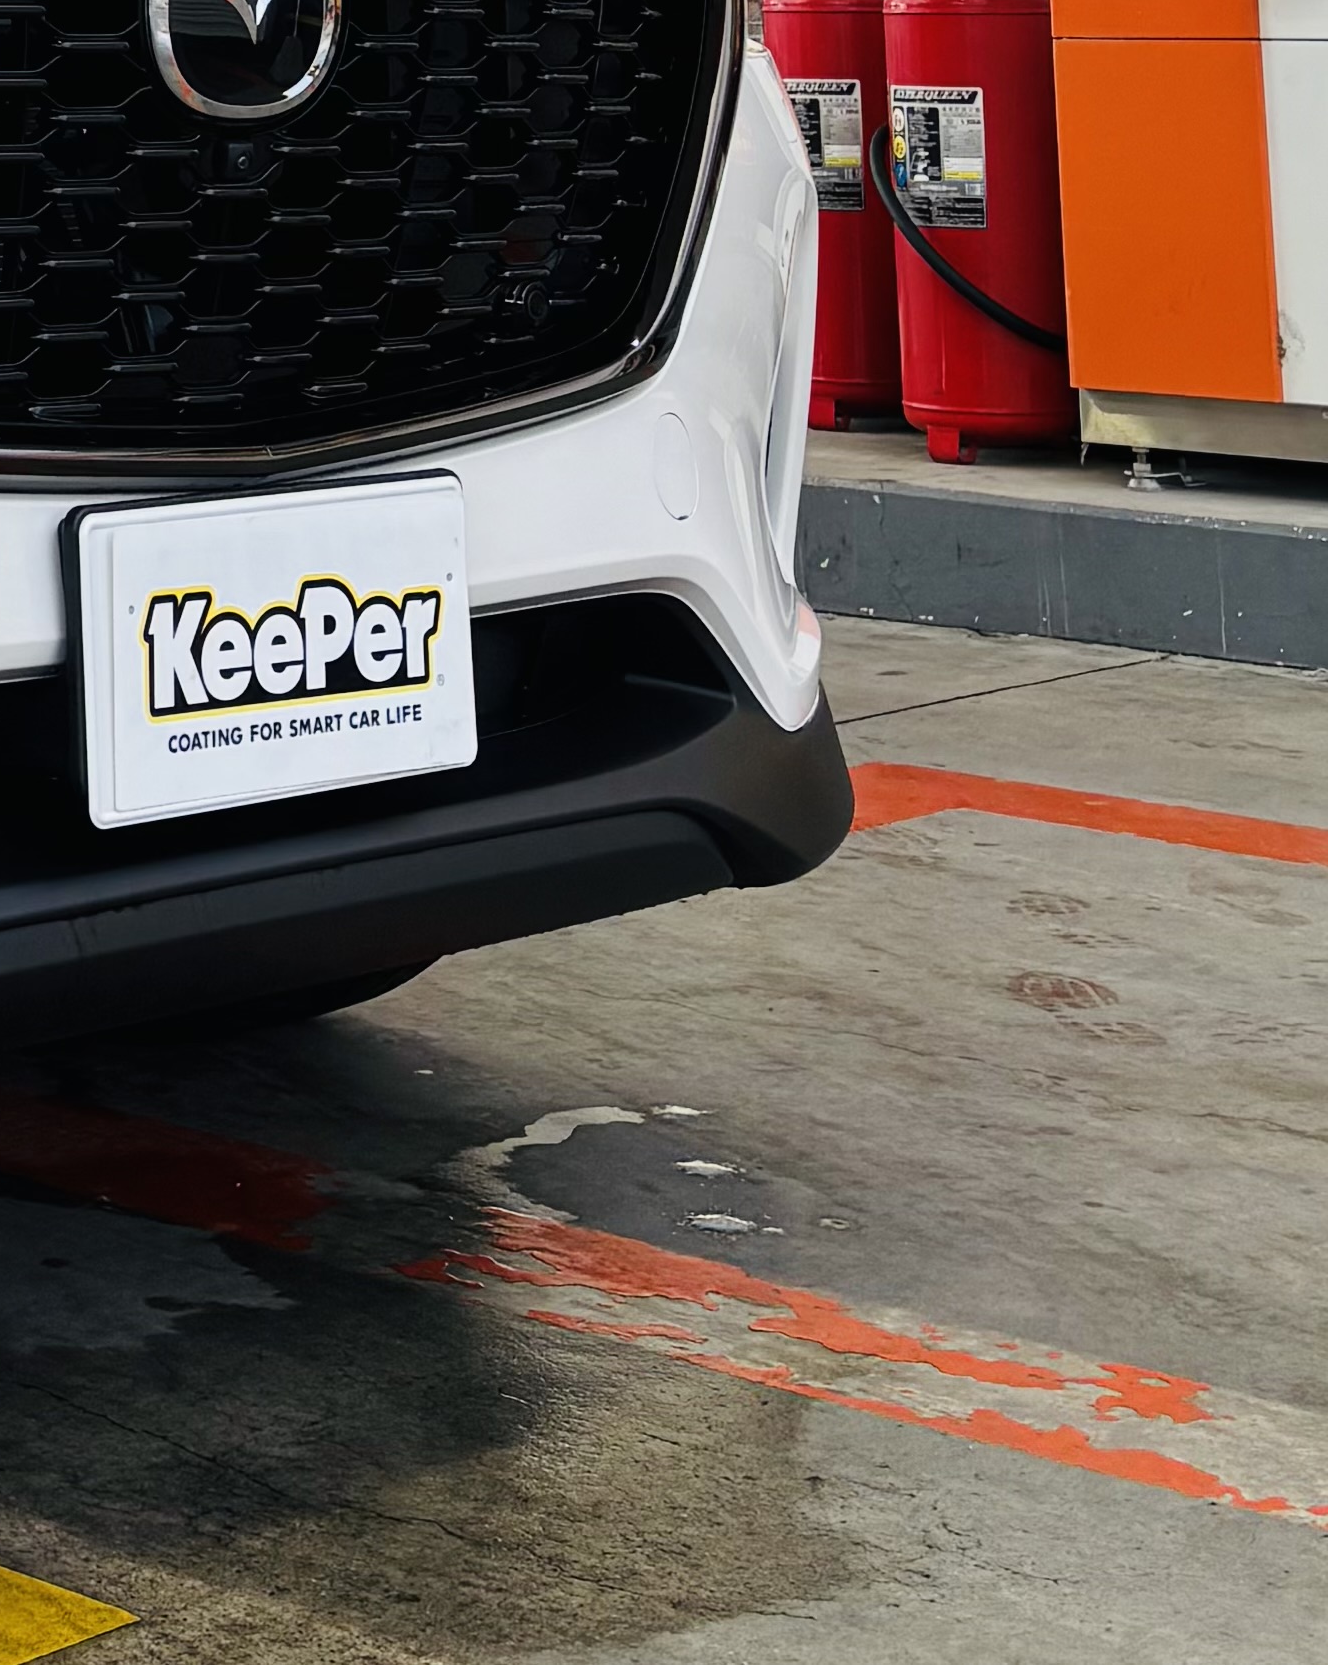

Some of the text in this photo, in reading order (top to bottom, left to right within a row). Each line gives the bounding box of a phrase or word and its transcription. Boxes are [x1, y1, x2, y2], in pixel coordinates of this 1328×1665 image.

[145, 581, 439, 714] KeePer
[168, 704, 422, 753] COATING FOR SMART CAR LIFE
